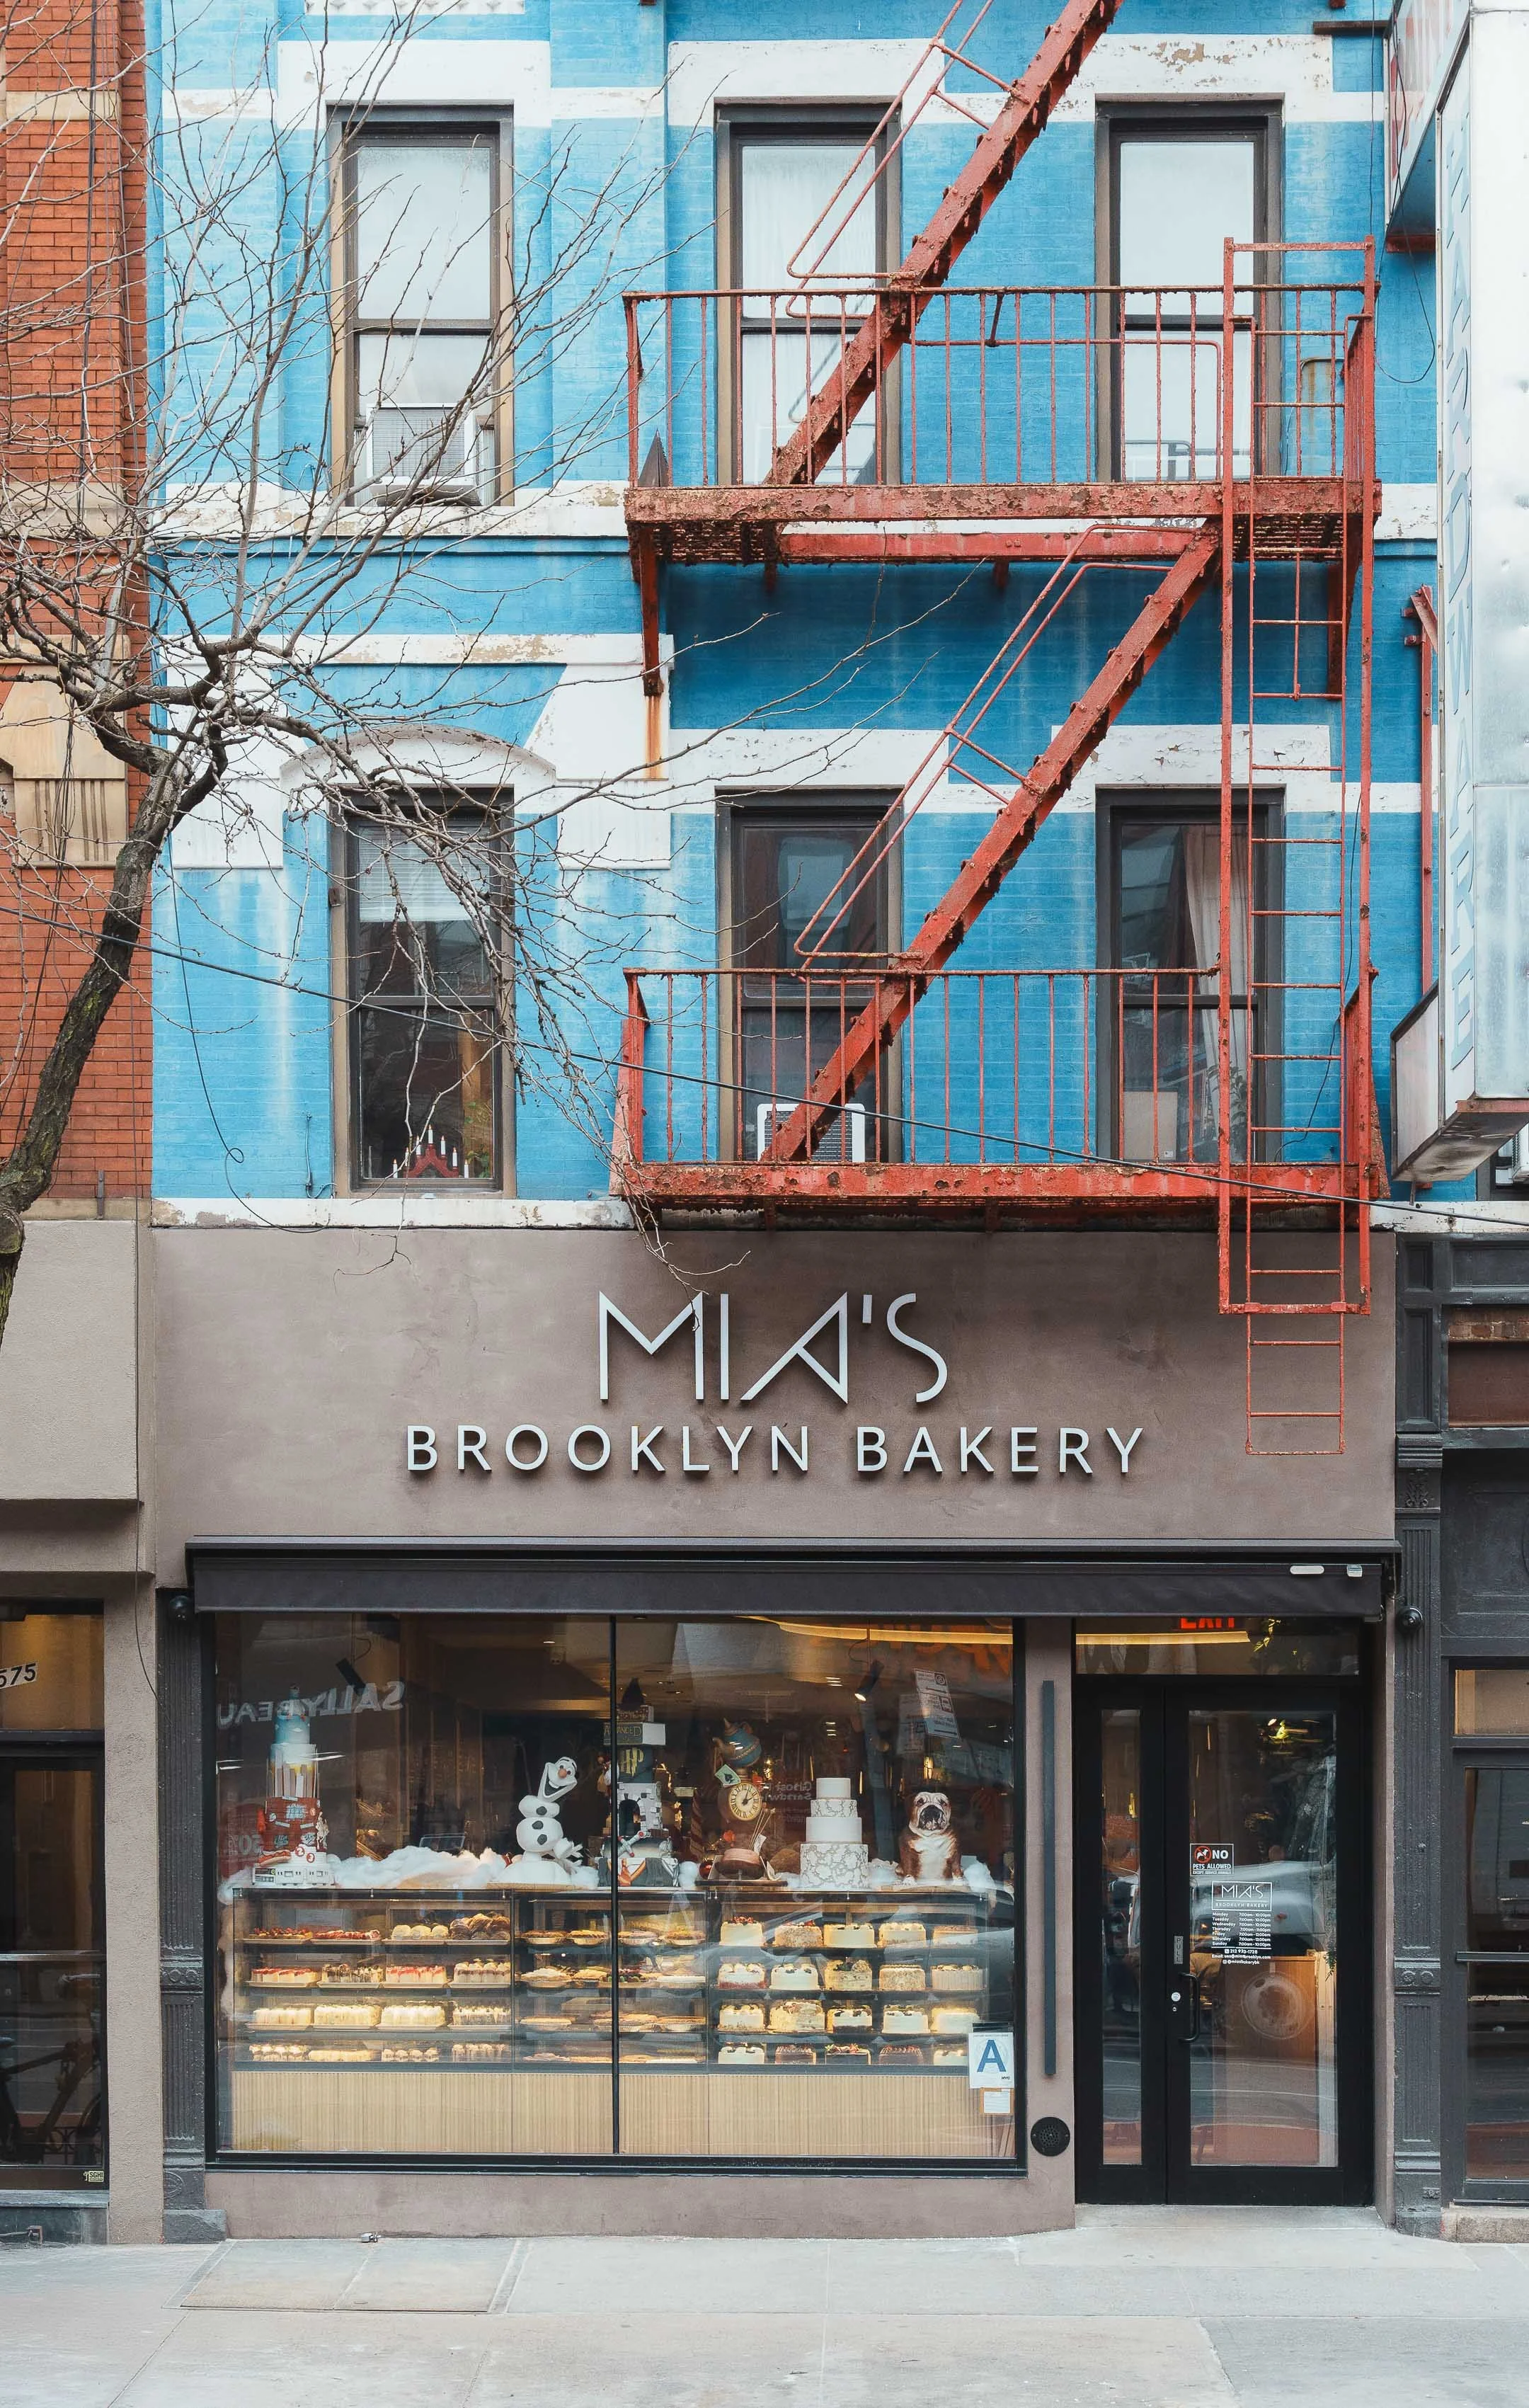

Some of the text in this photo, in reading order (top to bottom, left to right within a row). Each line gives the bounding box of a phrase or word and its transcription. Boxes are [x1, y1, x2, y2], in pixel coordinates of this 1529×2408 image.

[600, 1291, 947, 1403] MIA'S
[406, 1424, 1144, 1474] BROOKLYN BAKERY
[1212, 1849, 1229, 1860] NO
[1221, 1885, 1264, 1898] MIA'S
[976, 2039, 1007, 2072] A
